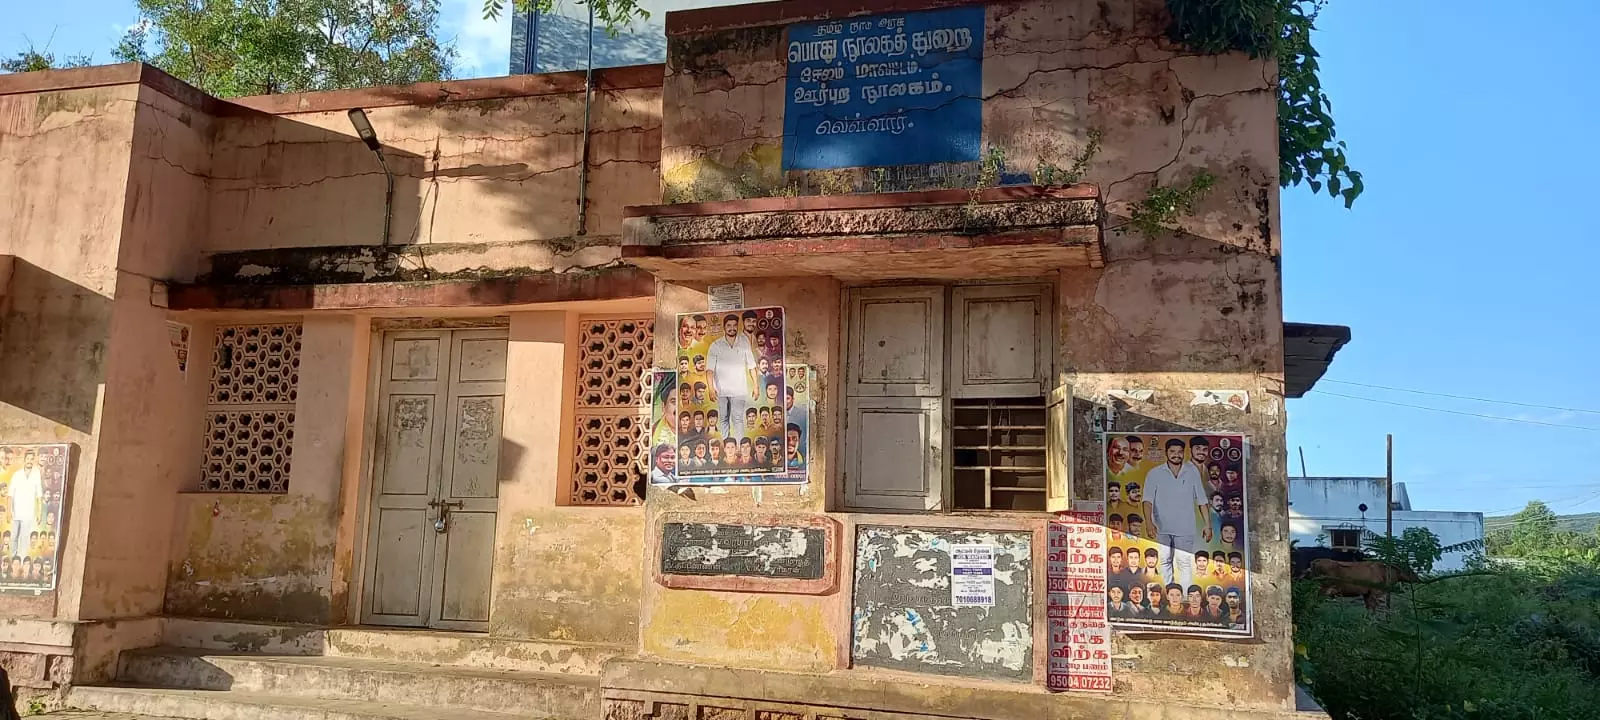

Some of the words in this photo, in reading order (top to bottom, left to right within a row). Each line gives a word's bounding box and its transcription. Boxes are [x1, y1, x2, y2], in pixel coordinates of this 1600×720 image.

[788, 39, 837, 64] பொது
[843, 28, 907, 62] நூலகத்
[912, 27, 972, 56] துறை
[801, 62, 844, 83] சேலம்
[1050, 534, 1101, 549] மீட்க
[1048, 549, 1104, 564] விற்க
[1077, 580, 1104, 592] 07232
[1053, 629, 1104, 644] மீட்க
[1051, 645, 1108, 661] விற்க
[1051, 675, 1079, 687] 95004
[1082, 677, 1110, 689] 07232
